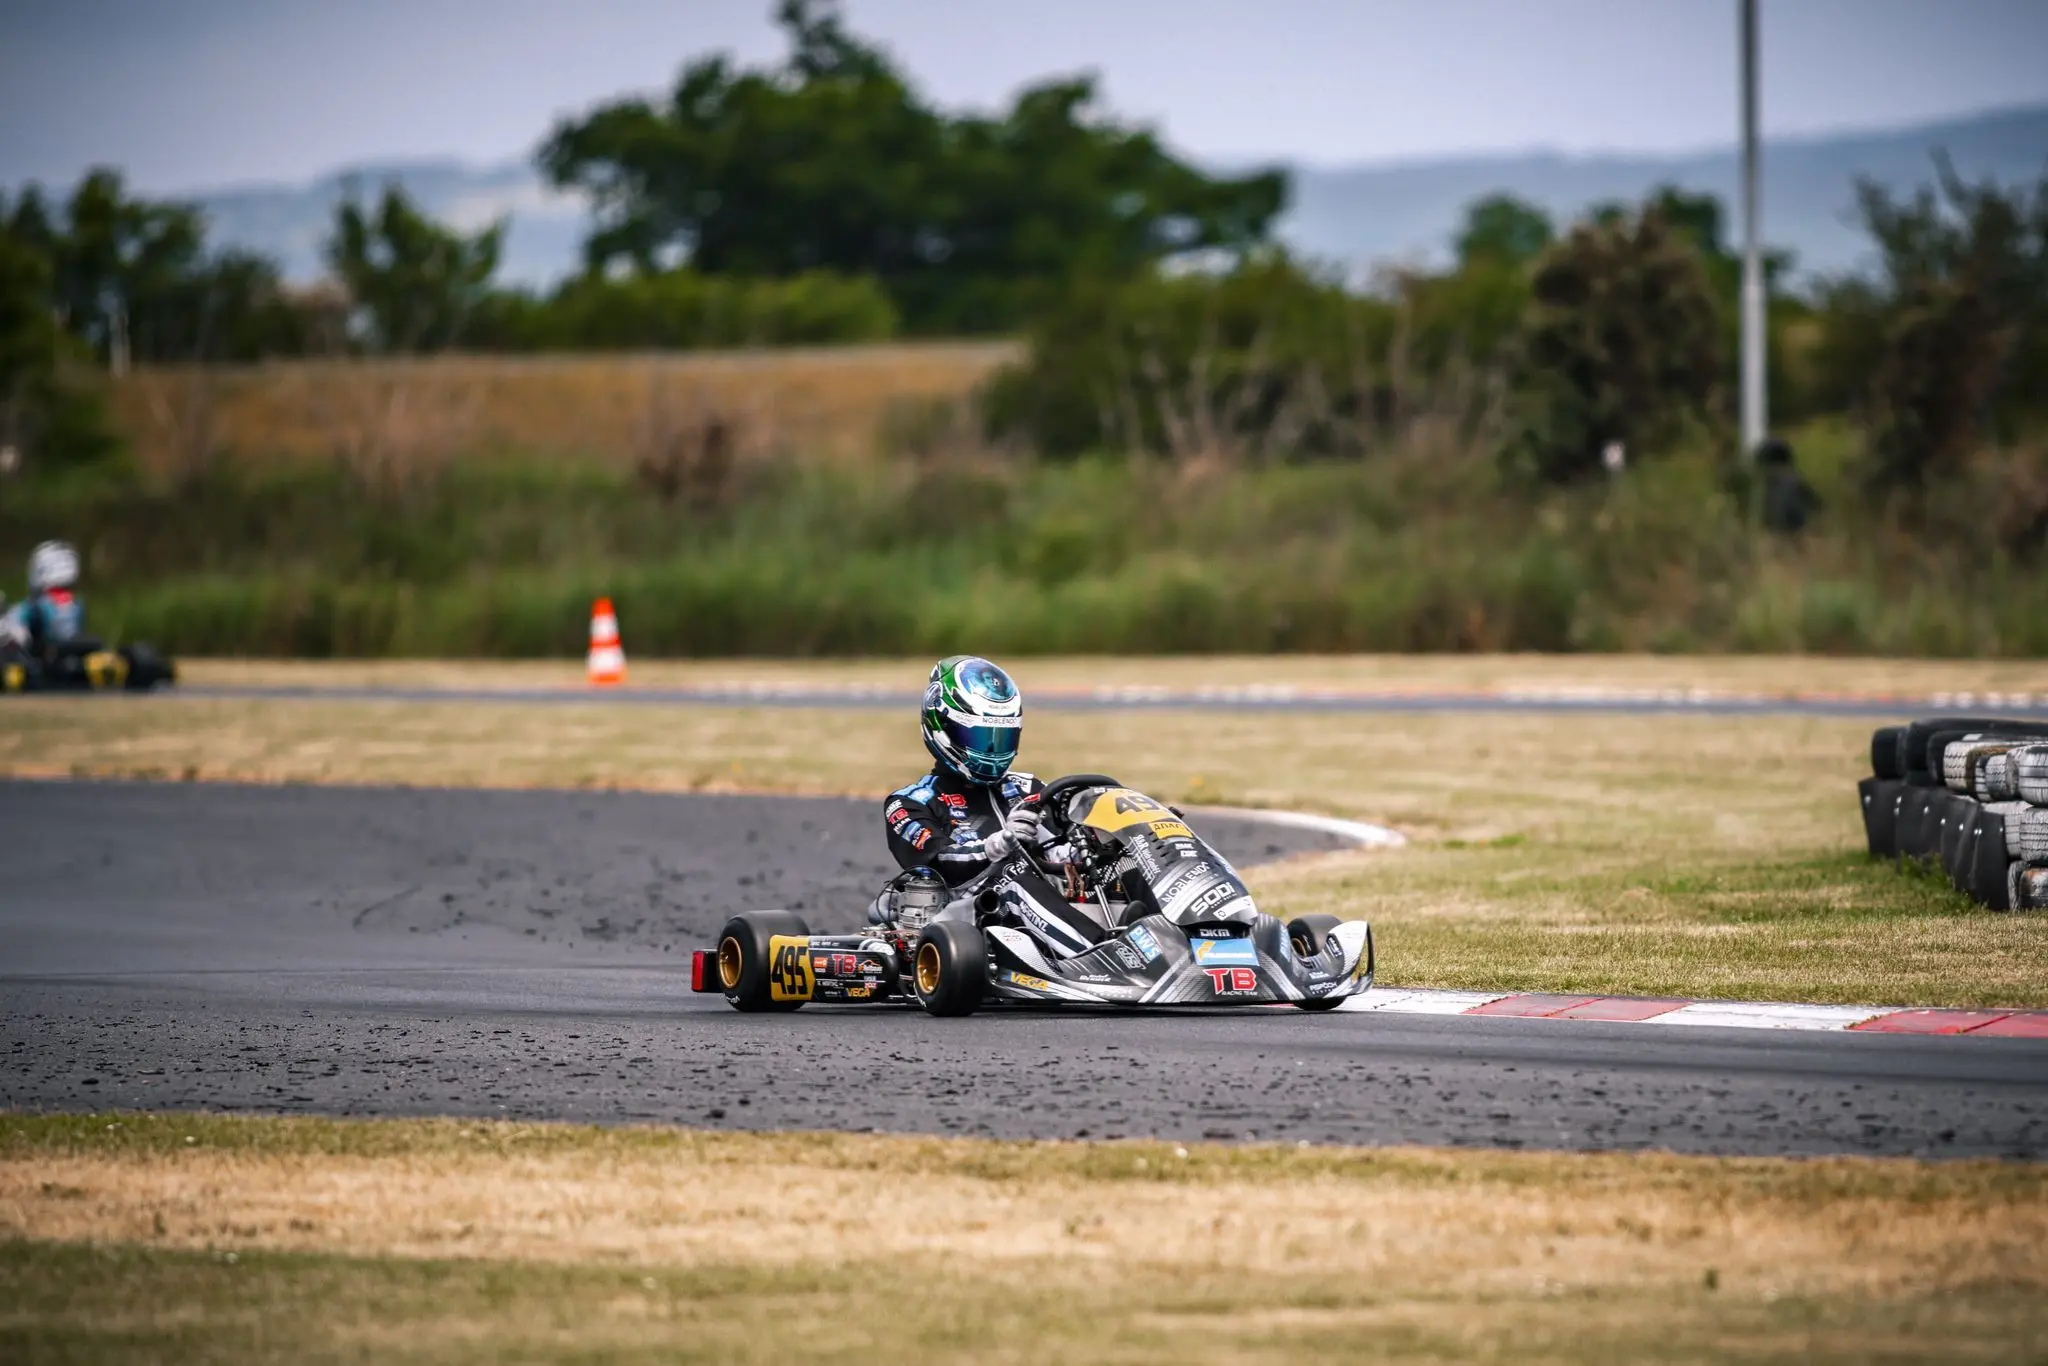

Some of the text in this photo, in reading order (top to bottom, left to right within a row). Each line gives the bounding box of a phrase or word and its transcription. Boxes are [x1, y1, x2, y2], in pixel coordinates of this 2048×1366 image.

[1190, 881, 1236, 917] SODI
[1130, 925, 1161, 959] PWS
[1200, 928, 1230, 937] DKM
[771, 945, 808, 994] 495
[832, 954, 857, 974] TB
[846, 987, 872, 997] VEGA
[1010, 971, 1049, 991] VEGA
[1202, 967, 1258, 995] TB
